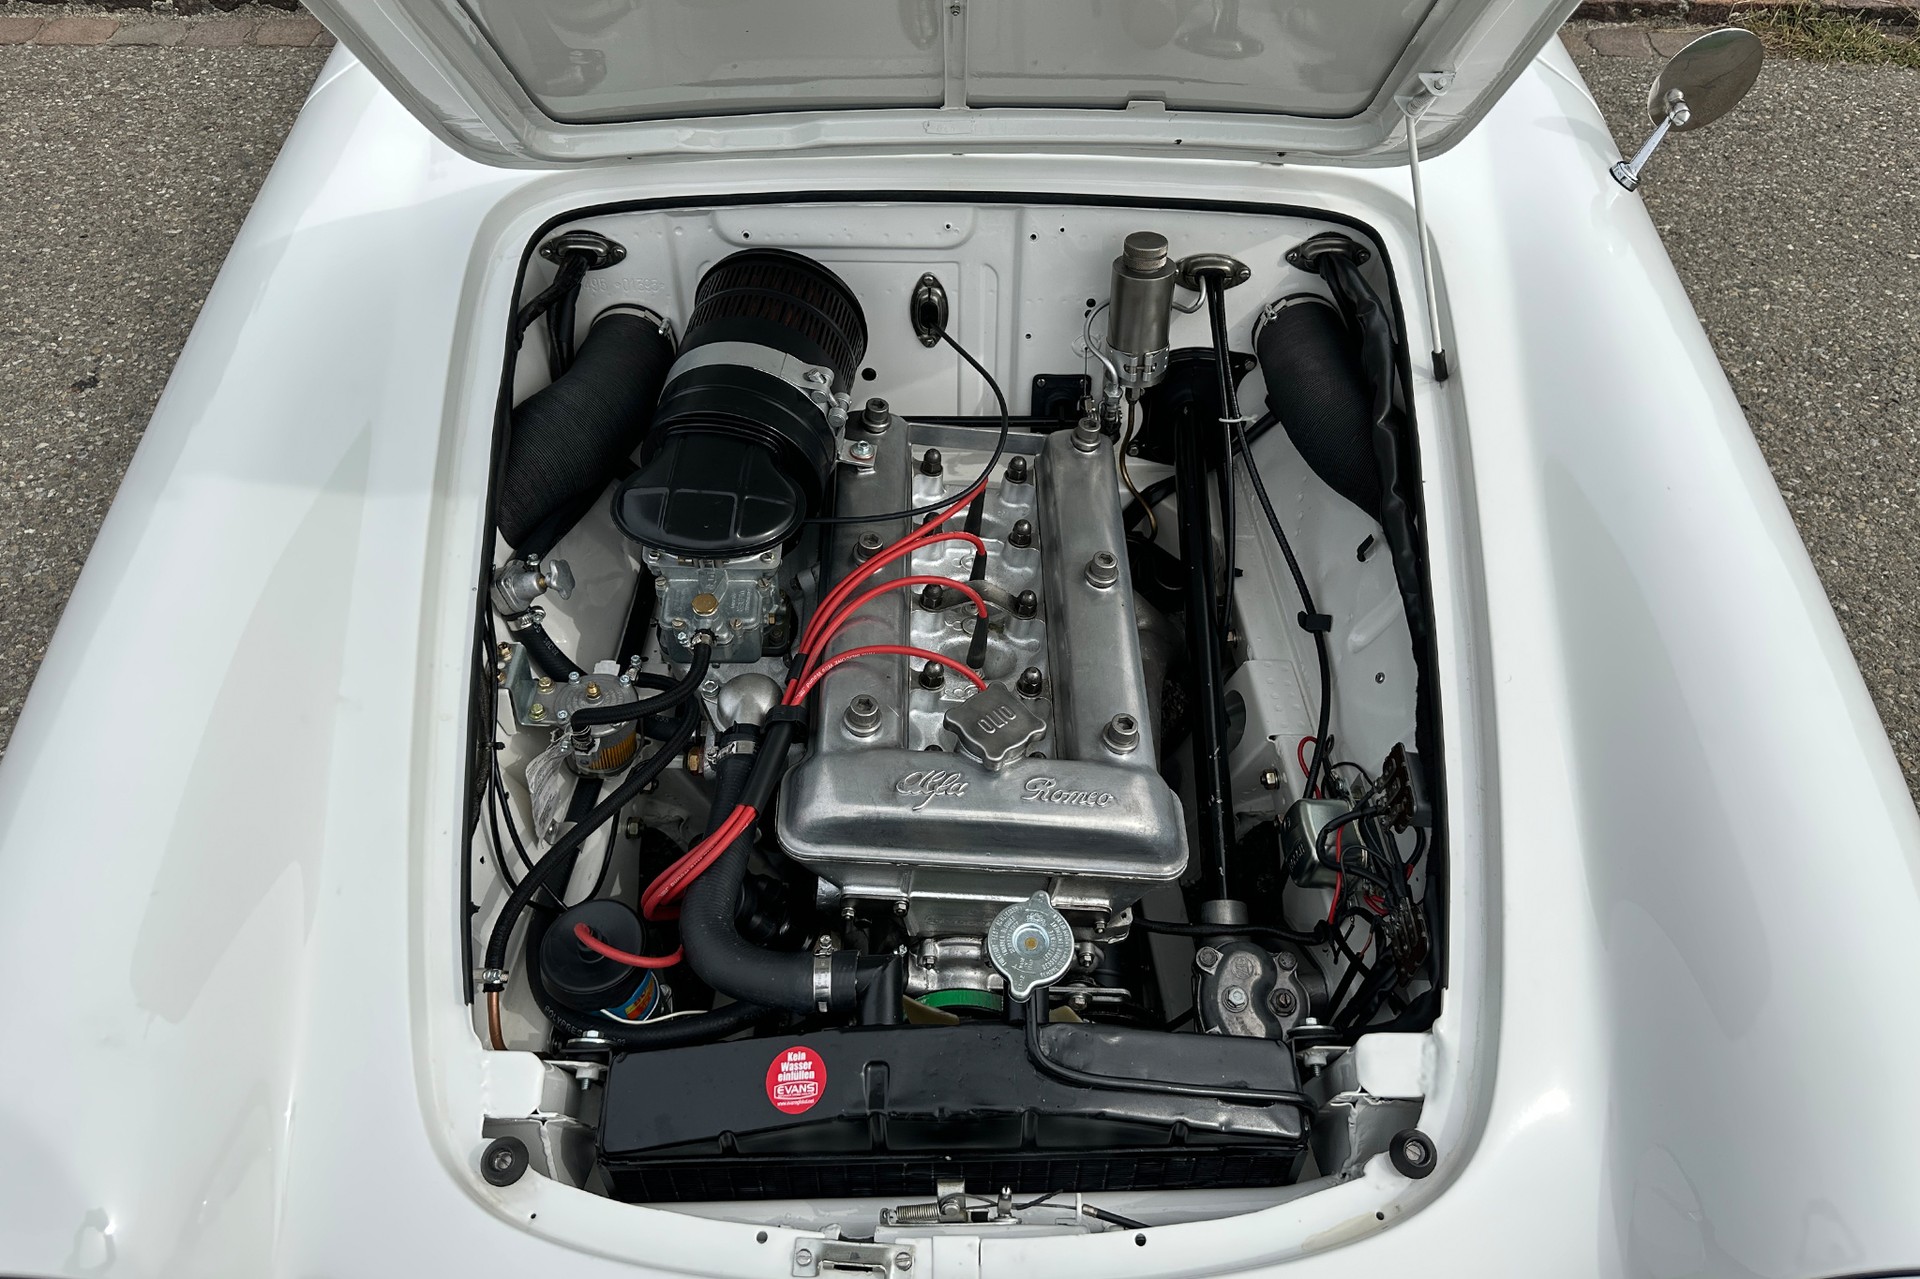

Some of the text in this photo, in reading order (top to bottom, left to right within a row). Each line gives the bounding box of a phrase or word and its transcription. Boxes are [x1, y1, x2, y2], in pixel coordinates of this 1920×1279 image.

[977, 705, 1017, 734] OLIO
[895, 769, 1114, 811] Alfa Romeo
[543, 1004, 583, 1037] POLYPRES
[787, 1051, 806, 1061] Kein
[781, 1061, 813, 1072] Wasser
[778, 1070, 815, 1081] einfüllen
[778, 1083, 815, 1094] EVANS
